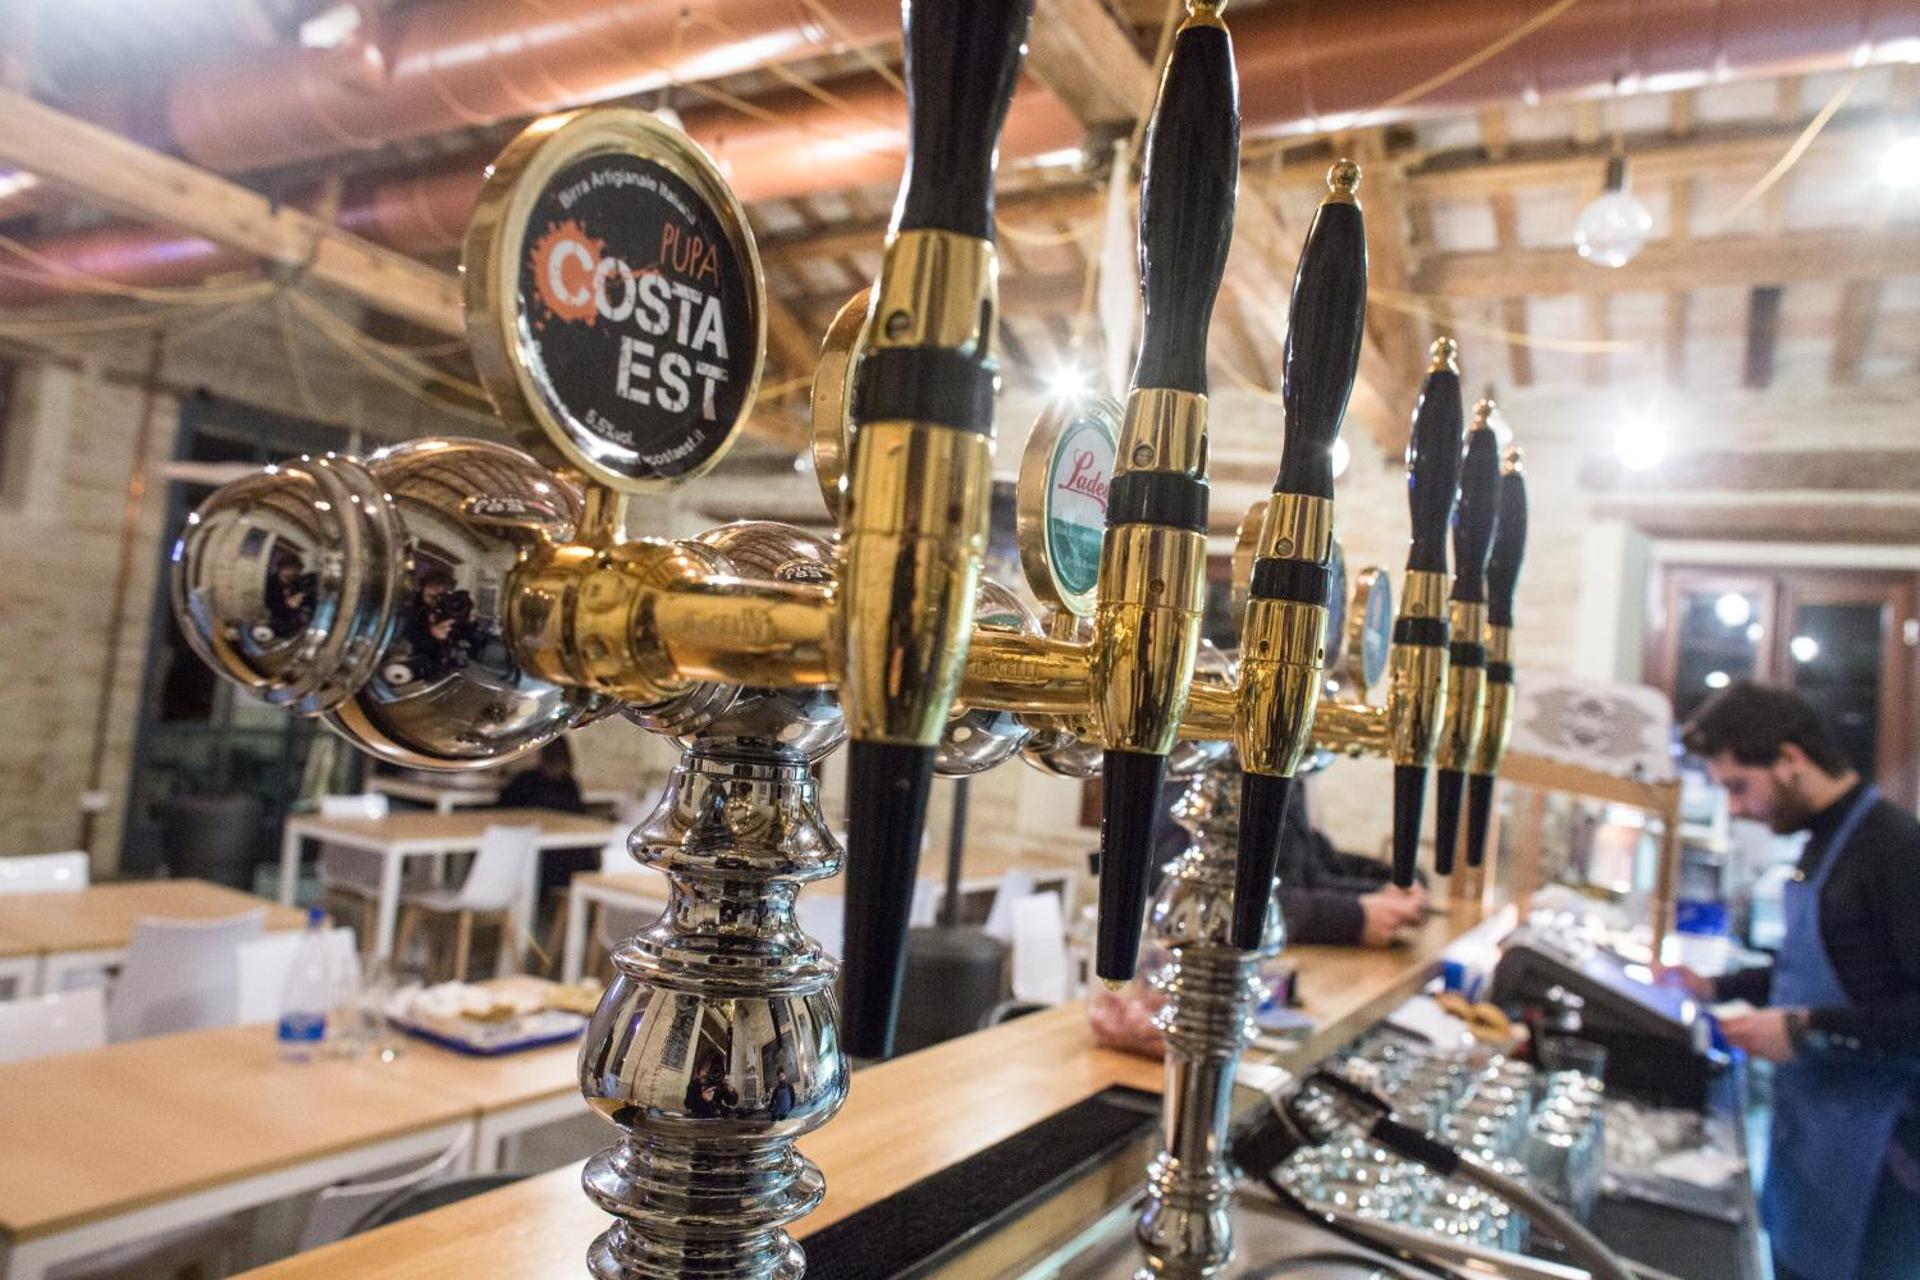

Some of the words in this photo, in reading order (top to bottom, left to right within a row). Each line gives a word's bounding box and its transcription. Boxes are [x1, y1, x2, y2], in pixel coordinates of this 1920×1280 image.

[558, 179, 591, 210] Birra
[591, 168, 659, 190] Artigianale
[660, 222, 720, 287] PUPA
[548, 239, 730, 361] COSTA
[615, 335, 729, 421] EST
